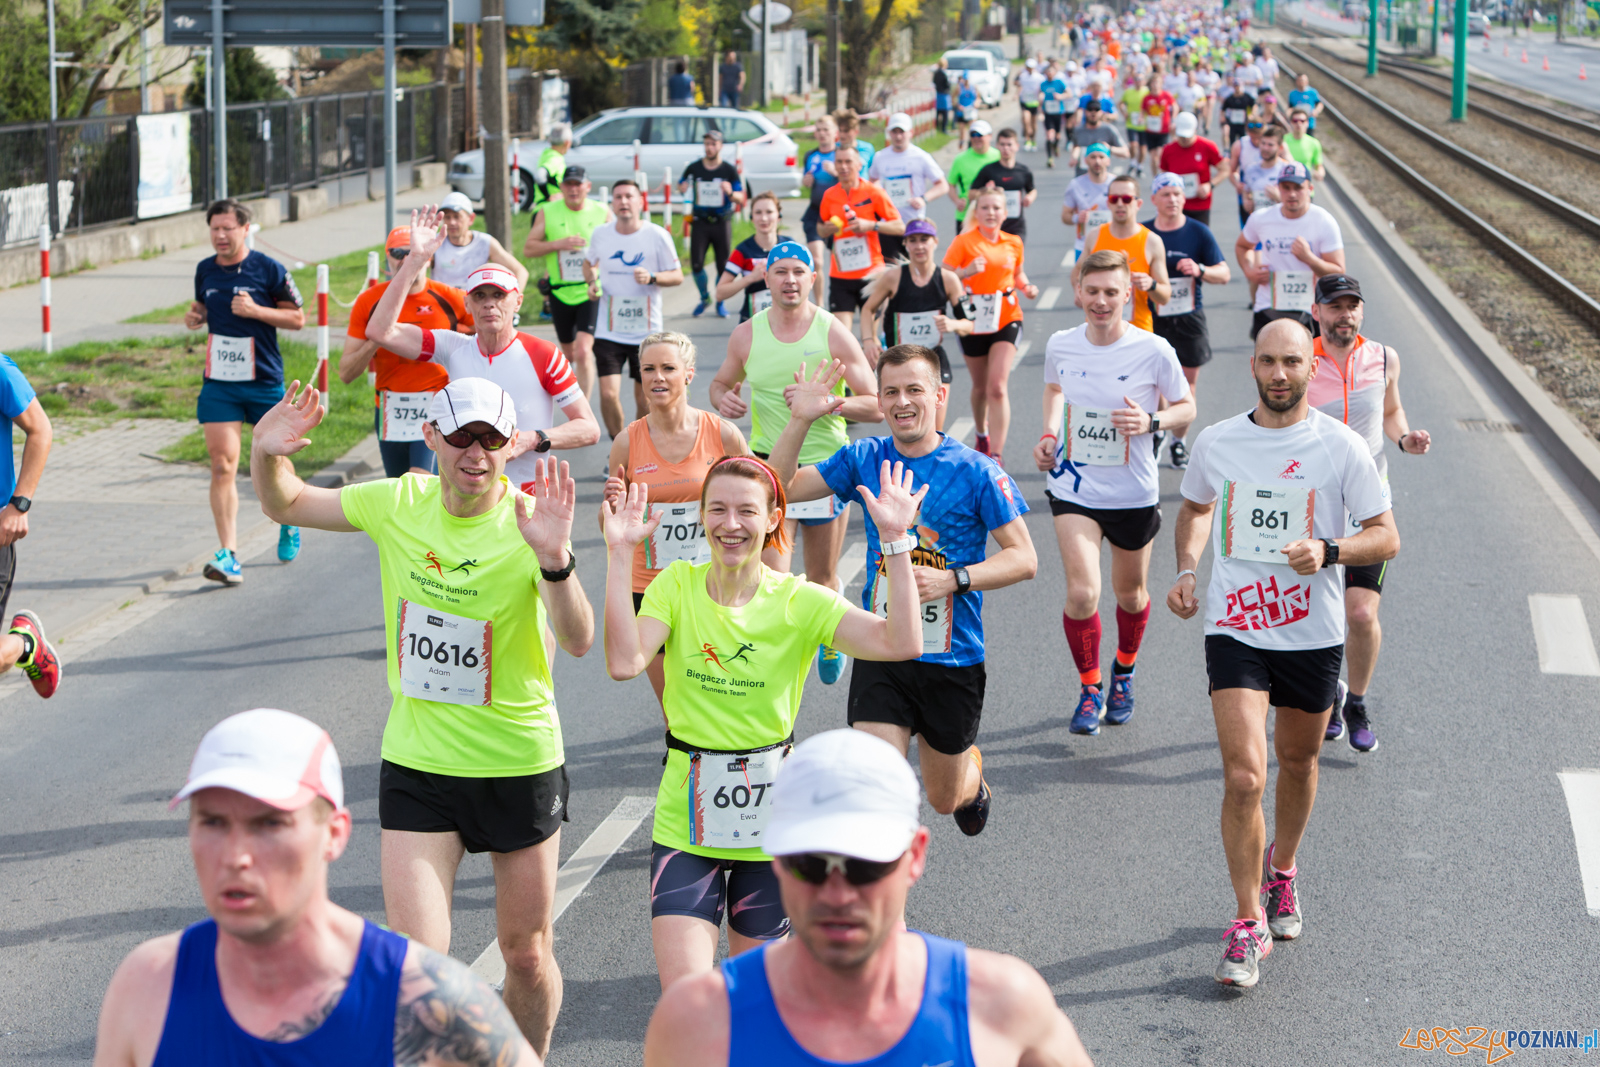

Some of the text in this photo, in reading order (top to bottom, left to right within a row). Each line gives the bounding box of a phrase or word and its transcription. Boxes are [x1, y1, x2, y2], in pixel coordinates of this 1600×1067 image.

[840, 245, 864, 257] 9087
[1282, 283, 1308, 293] 1222
[617, 307, 644, 317] 4818
[909, 324, 932, 335] 472
[217, 349, 246, 363] 1984
[393, 407, 428, 420] 3734
[1078, 425, 1117, 442] 6441
[1250, 508, 1289, 531] 861
[1258, 532, 1279, 540] Marek
[410, 571, 478, 597] Biegacze Juniora
[445, 595, 460, 604] Team
[409, 632, 479, 669] 10616
[428, 666, 451, 677] Adam
[686, 668, 765, 688] Biegacze Juniora
[701, 684, 747, 697] Runners Team
